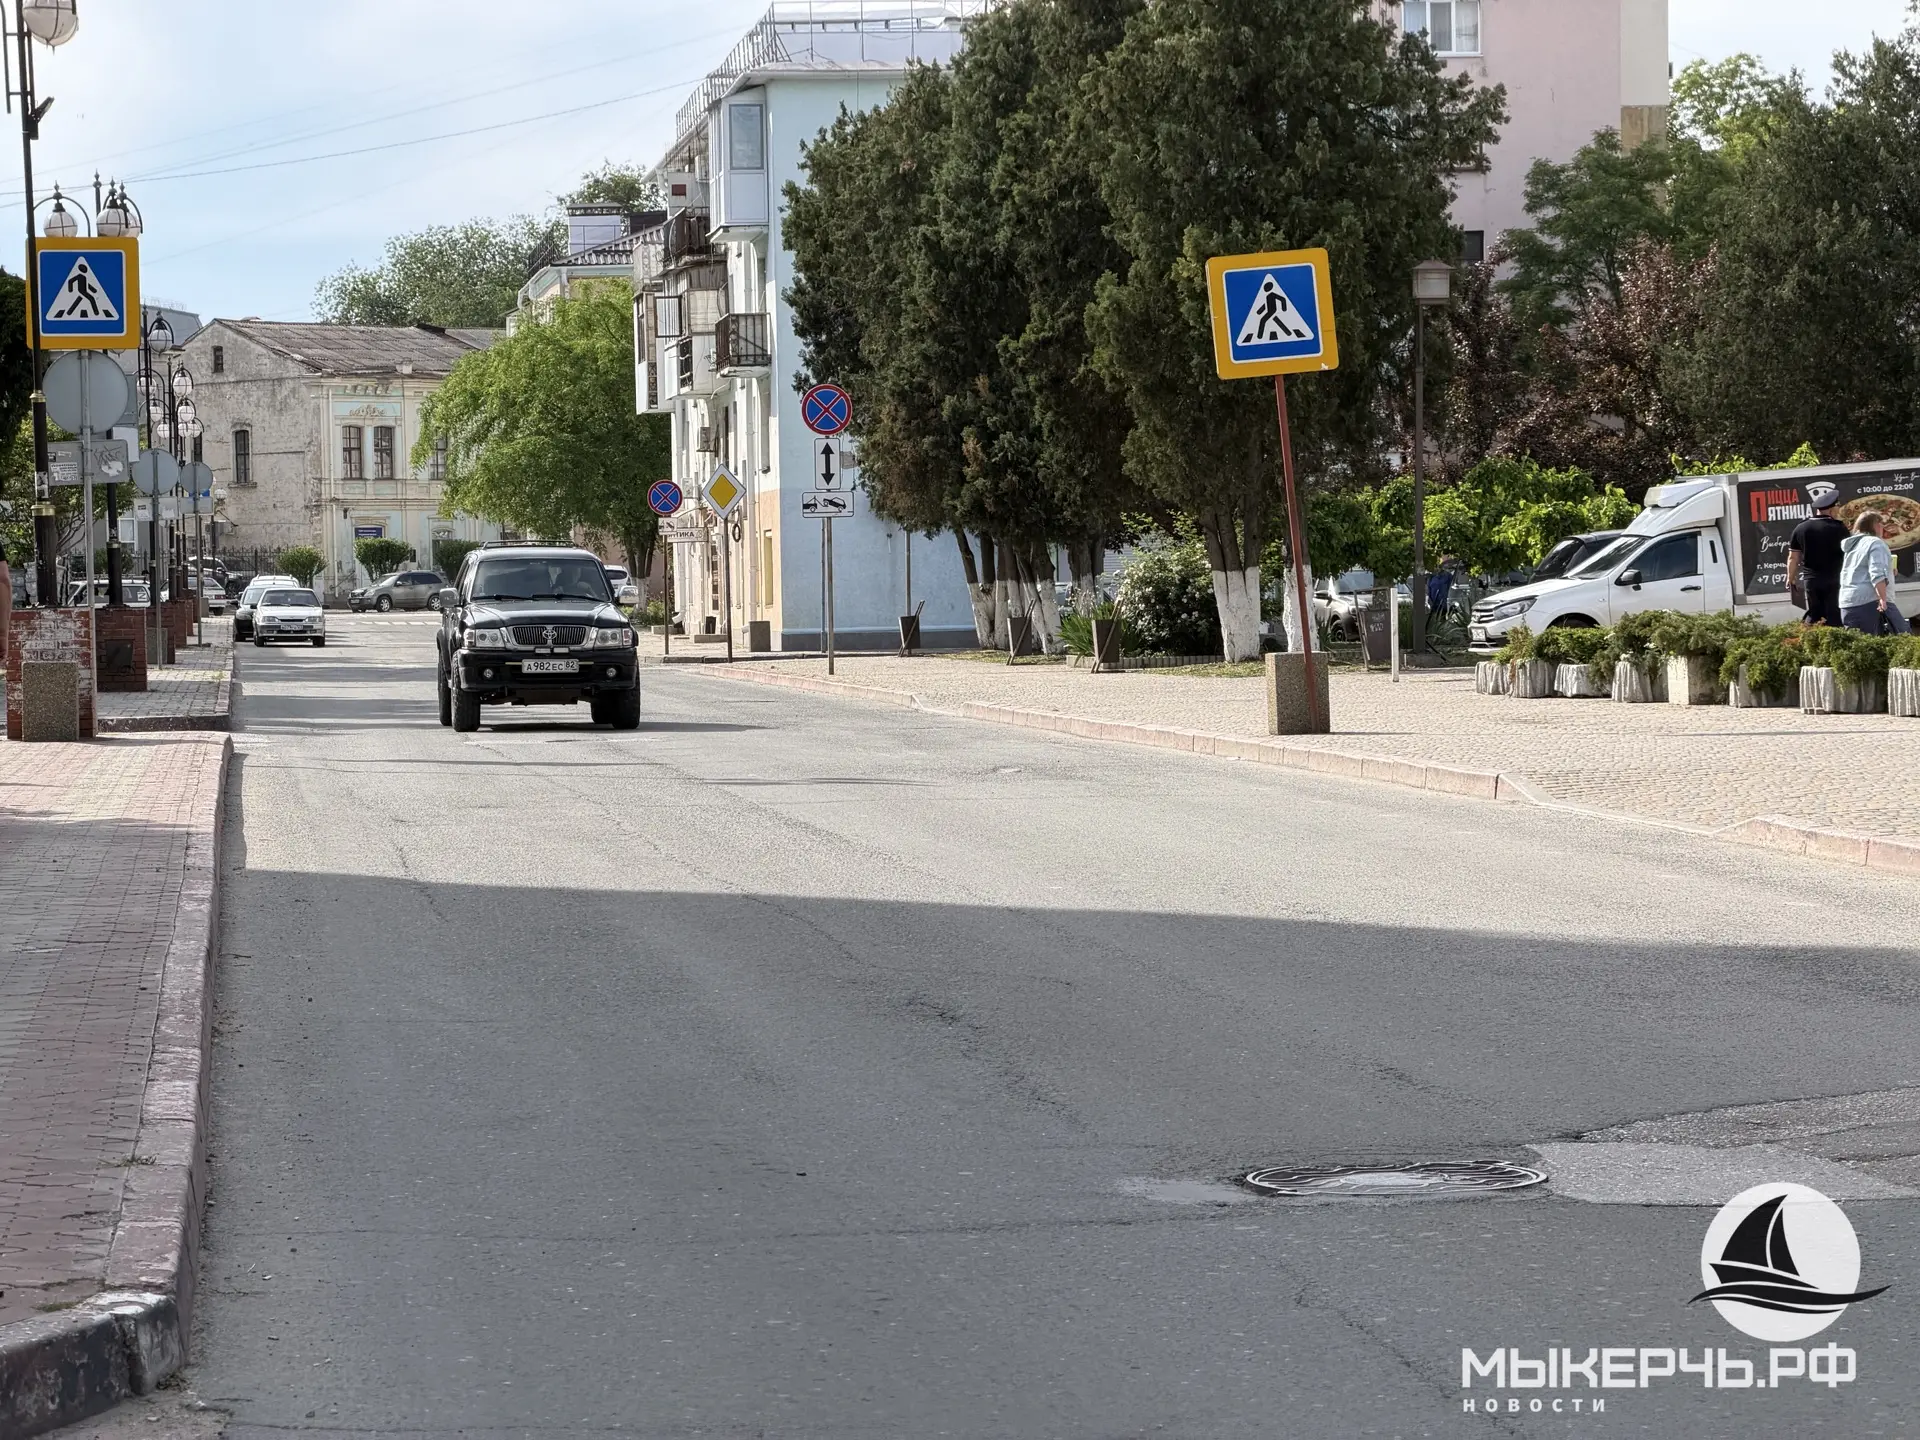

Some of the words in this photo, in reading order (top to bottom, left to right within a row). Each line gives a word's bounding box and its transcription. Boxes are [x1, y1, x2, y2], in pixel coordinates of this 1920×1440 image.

[1862, 485, 1882, 493] 10:00
[1893, 483, 1914, 491] 22:00
[1750, 488, 1800, 523] ПИЦЦА
[1757, 575, 1769, 584] +7
[1771, 573, 1787, 585] (97
